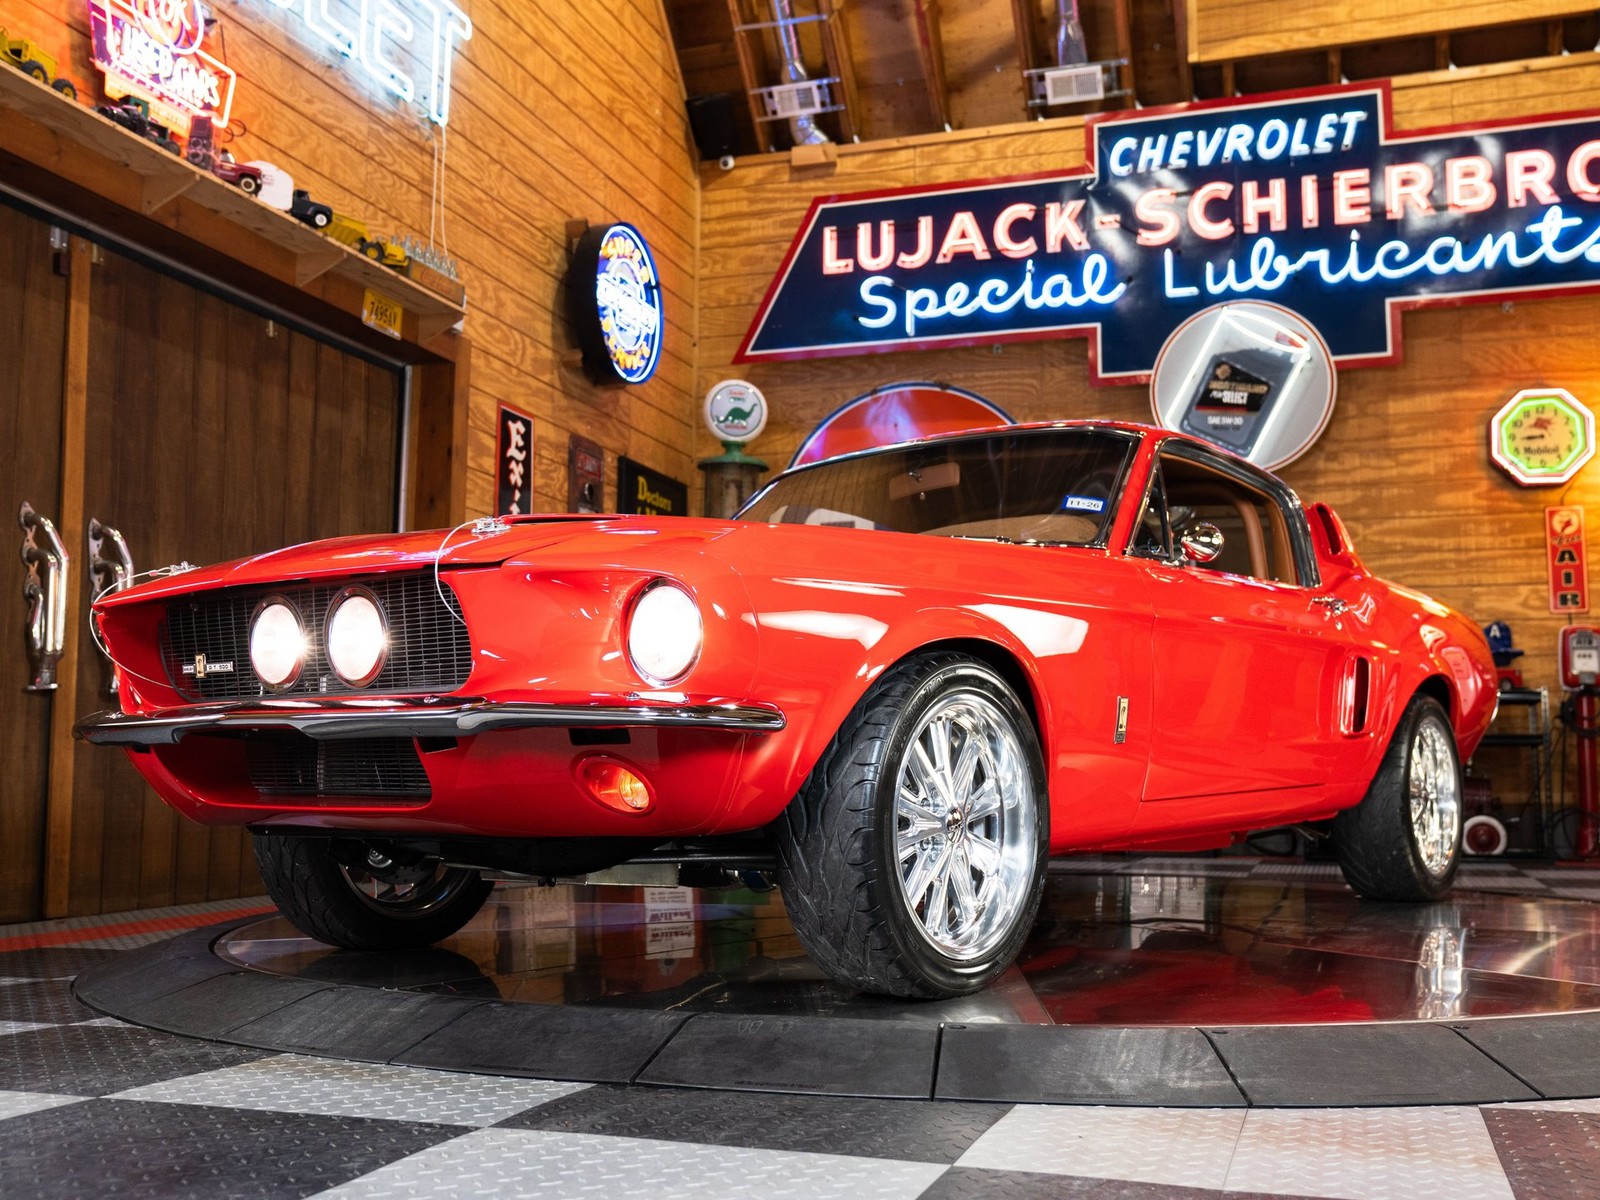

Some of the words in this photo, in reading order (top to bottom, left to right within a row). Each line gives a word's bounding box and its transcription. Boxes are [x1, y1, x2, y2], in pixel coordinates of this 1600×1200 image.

[1108, 110, 1368, 178] CHEVROLET
[857, 252, 1127, 337] Special
[1069, 500, 1100, 509] 11-26
[1554, 548, 1581, 608] AIR
[1489, 624, 1501, 638] A
